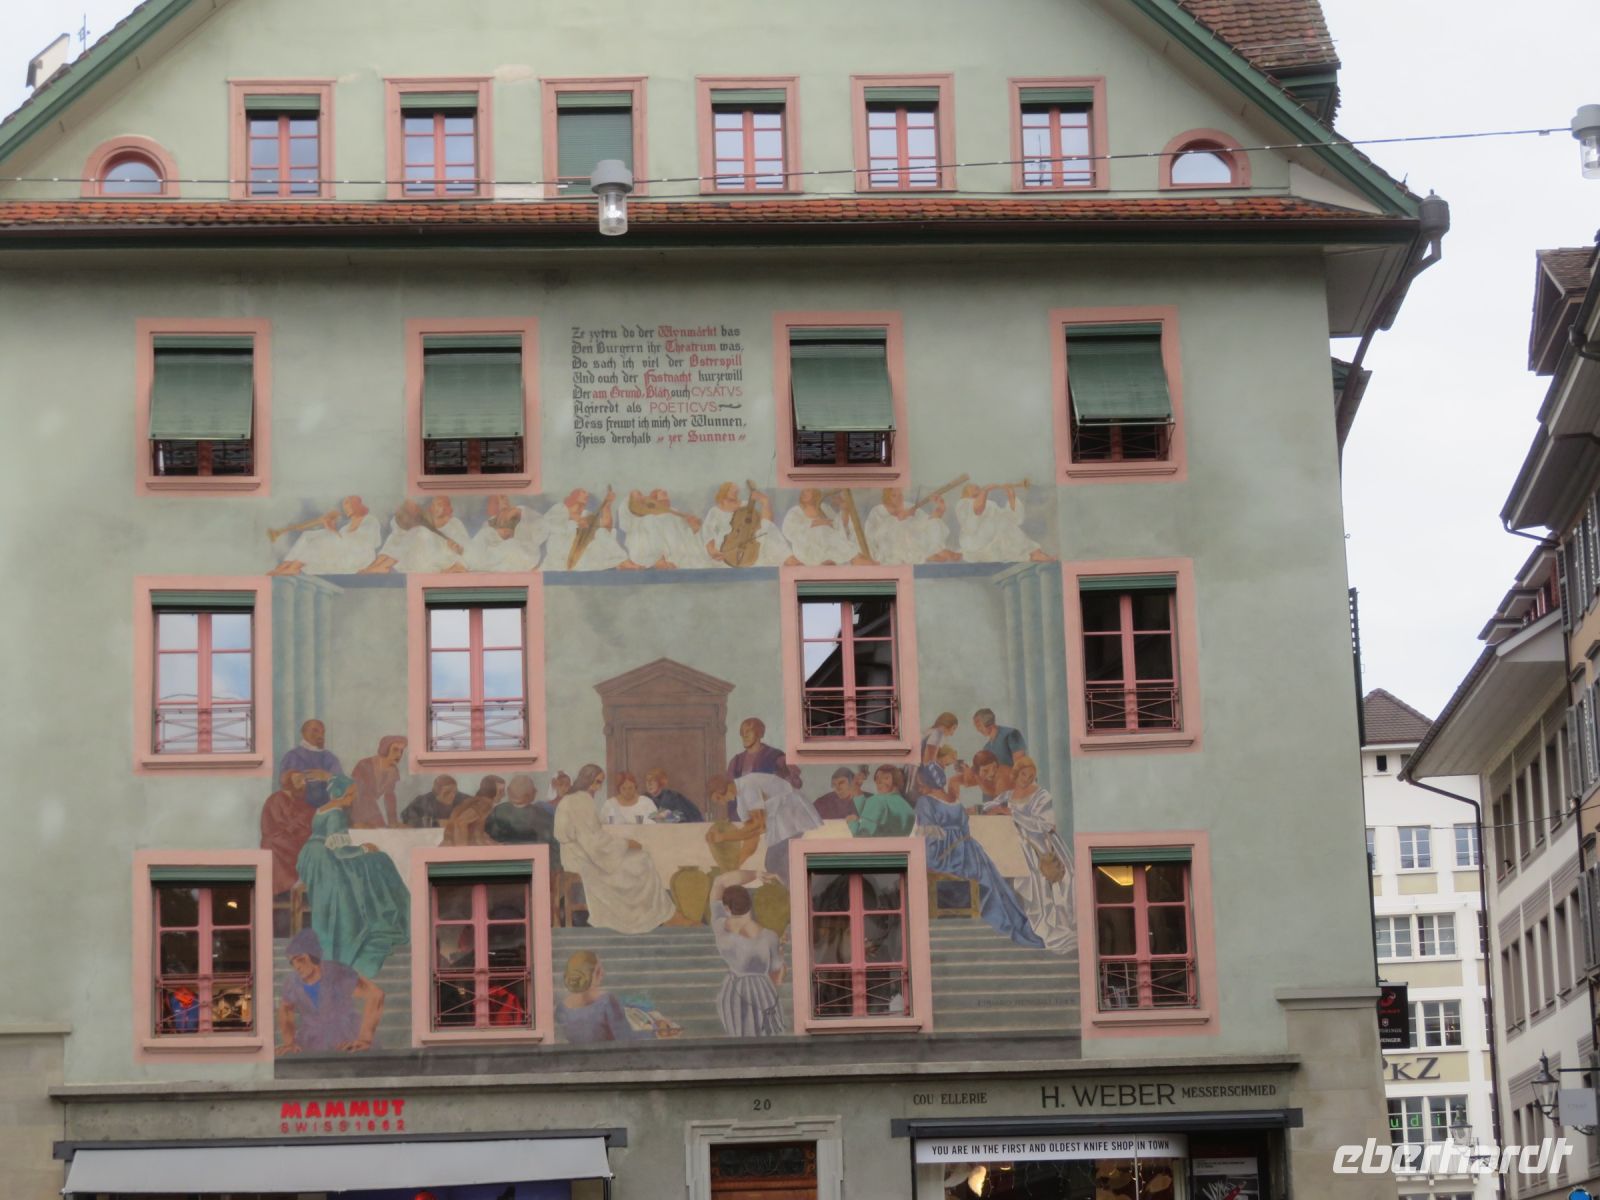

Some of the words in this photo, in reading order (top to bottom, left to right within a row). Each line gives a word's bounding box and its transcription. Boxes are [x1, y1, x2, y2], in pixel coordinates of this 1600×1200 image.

[636, 324, 654, 338] der
[665, 339, 717, 353] Theatrum
[622, 356, 635, 370] ich
[642, 356, 659, 369] viel
[665, 354, 684, 368] der
[622, 370, 639, 383] der
[592, 389, 607, 399] am
[626, 401, 642, 413] als
[638, 416, 650, 431] ich
[651, 416, 671, 431] mich
[672, 414, 688, 427] der
[1072, 1083, 1176, 1108] WEBER
[1182, 1084, 1276, 1098] MESSERSCHMIED
[281, 1099, 405, 1119] MAMMUT
[753, 1098, 772, 1111] 20
[932, 1145, 949, 1155] YOU
[952, 1144, 969, 1155] ARE
[971, 1144, 981, 1154] IN
[983, 1144, 999, 1154] THE
[1002, 1143, 1026, 1153] FIRST
[1029, 1143, 1046, 1153] AND
[1049, 1142, 1080, 1152] OLDEST
[1083, 1141, 1109, 1152] KNIFE
[1111, 1140, 1134, 1150] SHOP
[1137, 1140, 1145, 1150] IN
[1149, 1140, 1170, 1150] TOWN
